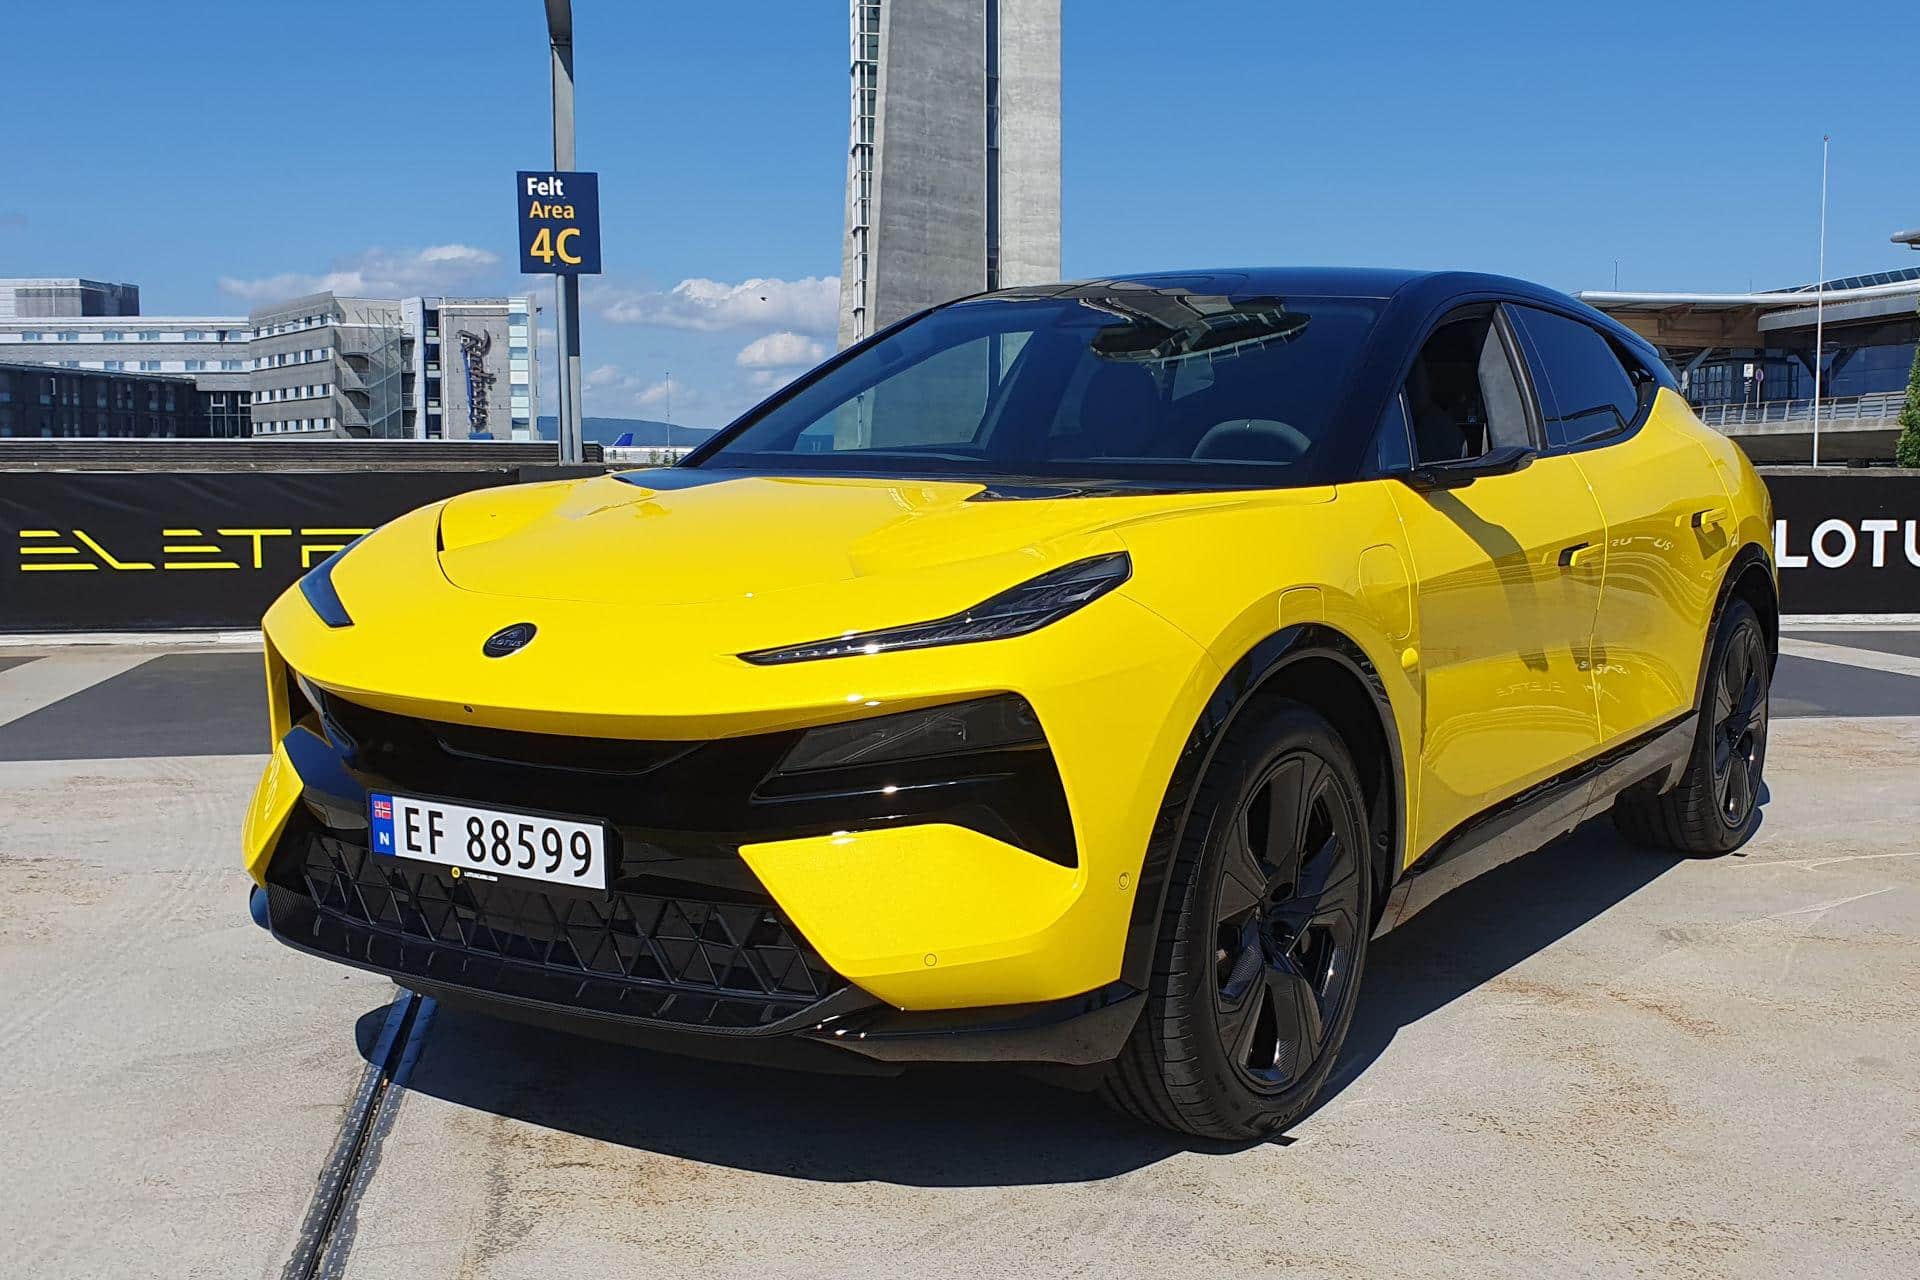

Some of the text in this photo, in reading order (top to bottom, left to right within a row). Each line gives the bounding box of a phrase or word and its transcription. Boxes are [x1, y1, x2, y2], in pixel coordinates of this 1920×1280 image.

[527, 176, 564, 196] Felt
[529, 200, 575, 219] Area
[530, 228, 582, 264] 4C
[379, 831, 390, 846] N
[404, 806, 592, 878] EF 88599
